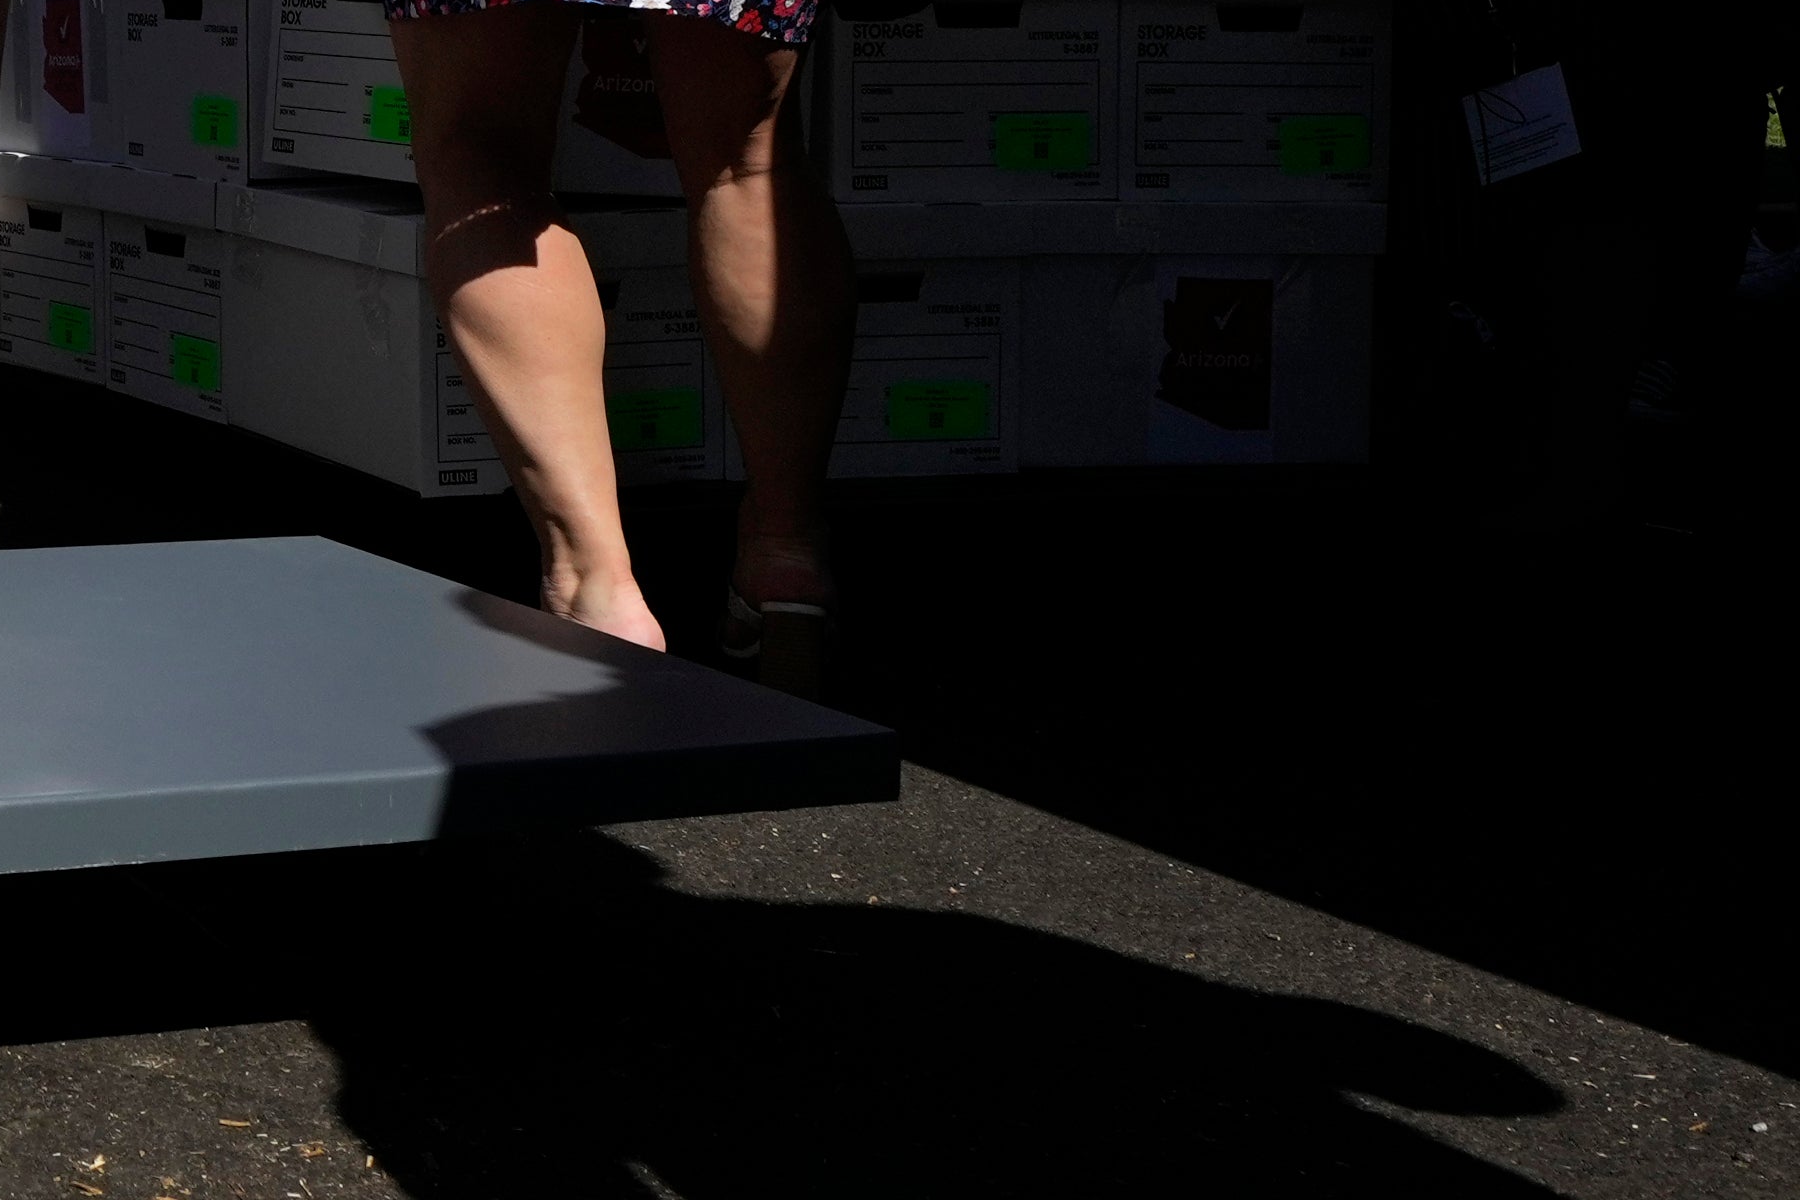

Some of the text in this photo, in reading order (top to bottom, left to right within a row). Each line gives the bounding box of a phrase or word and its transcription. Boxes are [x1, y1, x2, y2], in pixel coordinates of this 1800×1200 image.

[128, 13, 158, 27] STORAGE
[281, 10, 301, 25] BOX
[128, 28, 143, 42] BOX
[853, 23, 923, 39] STORAGE
[1138, 25, 1206, 40] STORAGE
[853, 42, 886, 57] BOX
[1138, 43, 1169, 57] BOX
[593, 74, 655, 94] Arizon
[853, 175, 887, 190] ULINE
[1137, 174, 1169, 187] ULINE
[110, 241, 141, 259] STORAGE
[110, 257, 124, 271] BOX
[1175, 348, 1250, 368] Arizona
[441, 471, 476, 484] ULINE
